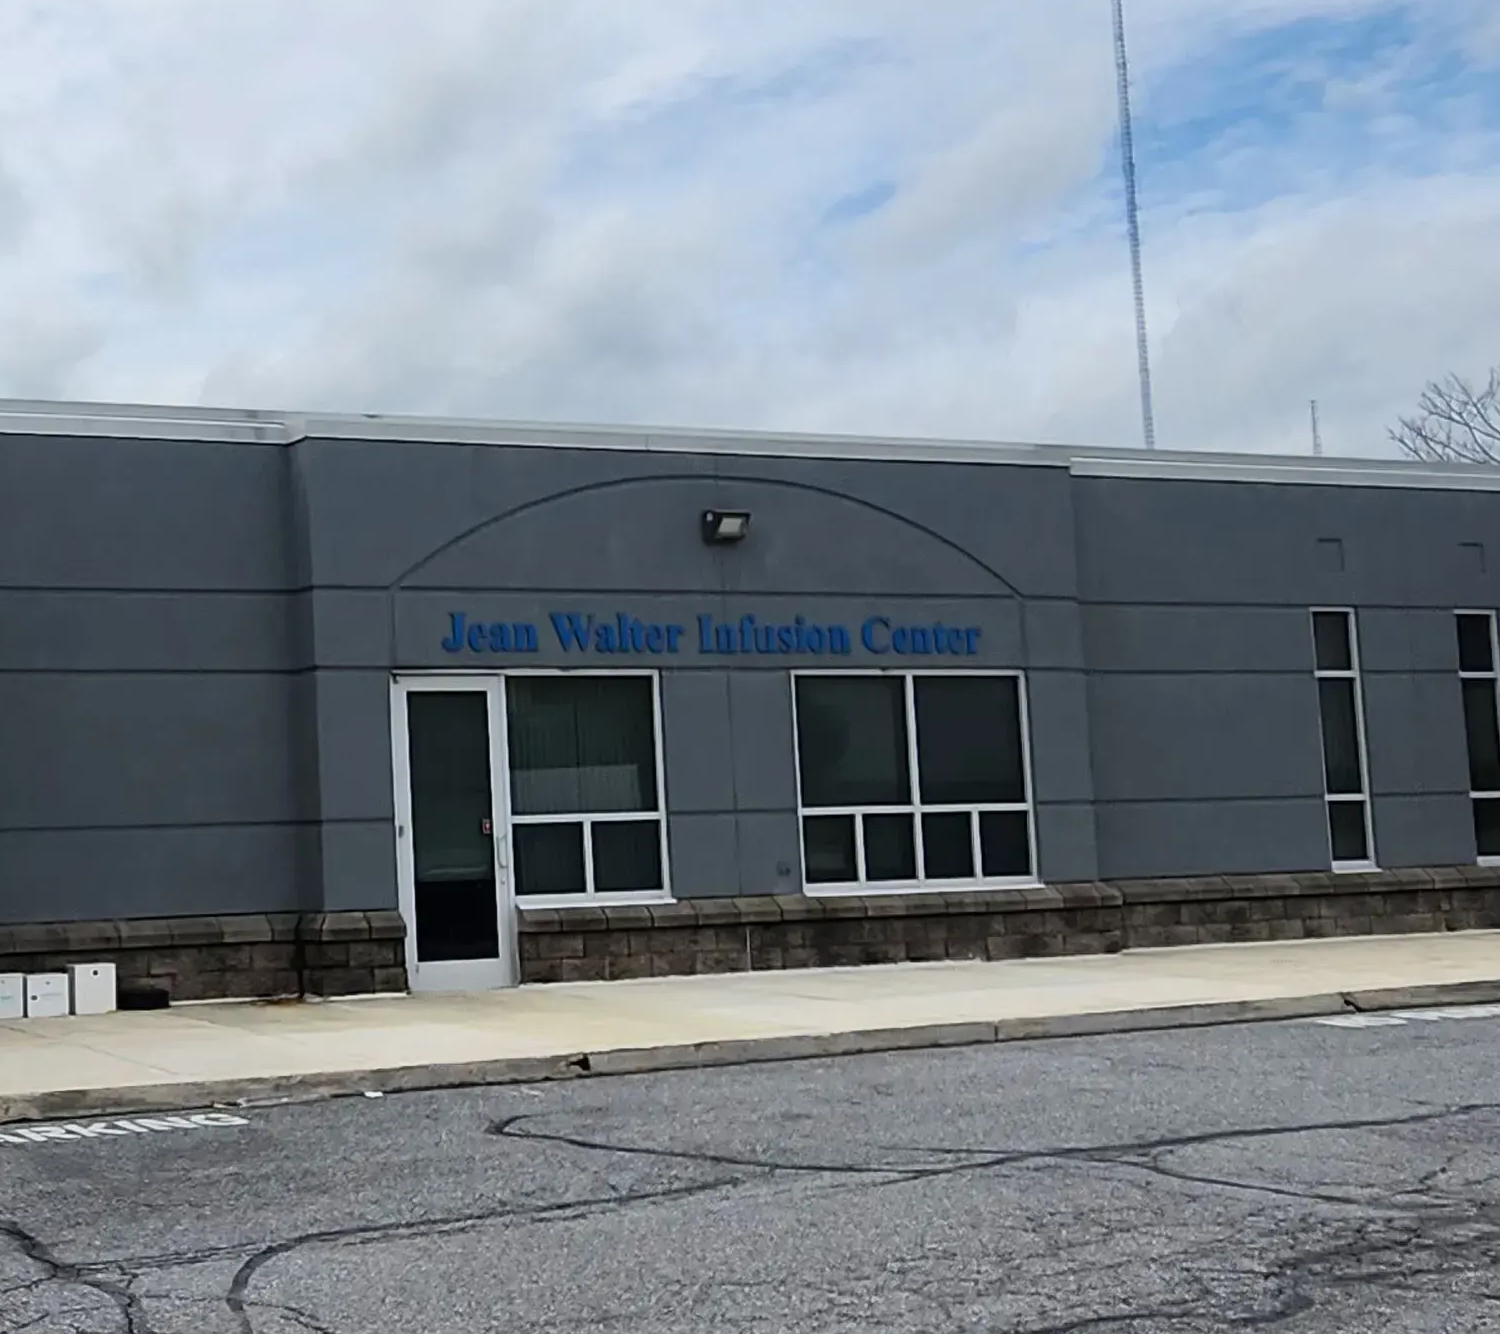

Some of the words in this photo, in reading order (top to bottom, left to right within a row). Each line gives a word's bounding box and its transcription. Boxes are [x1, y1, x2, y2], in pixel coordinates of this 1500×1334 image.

[441, 612, 539, 653] Jean
[548, 612, 684, 653] Walter
[697, 614, 852, 654] Infusion
[860, 616, 981, 655] Center
